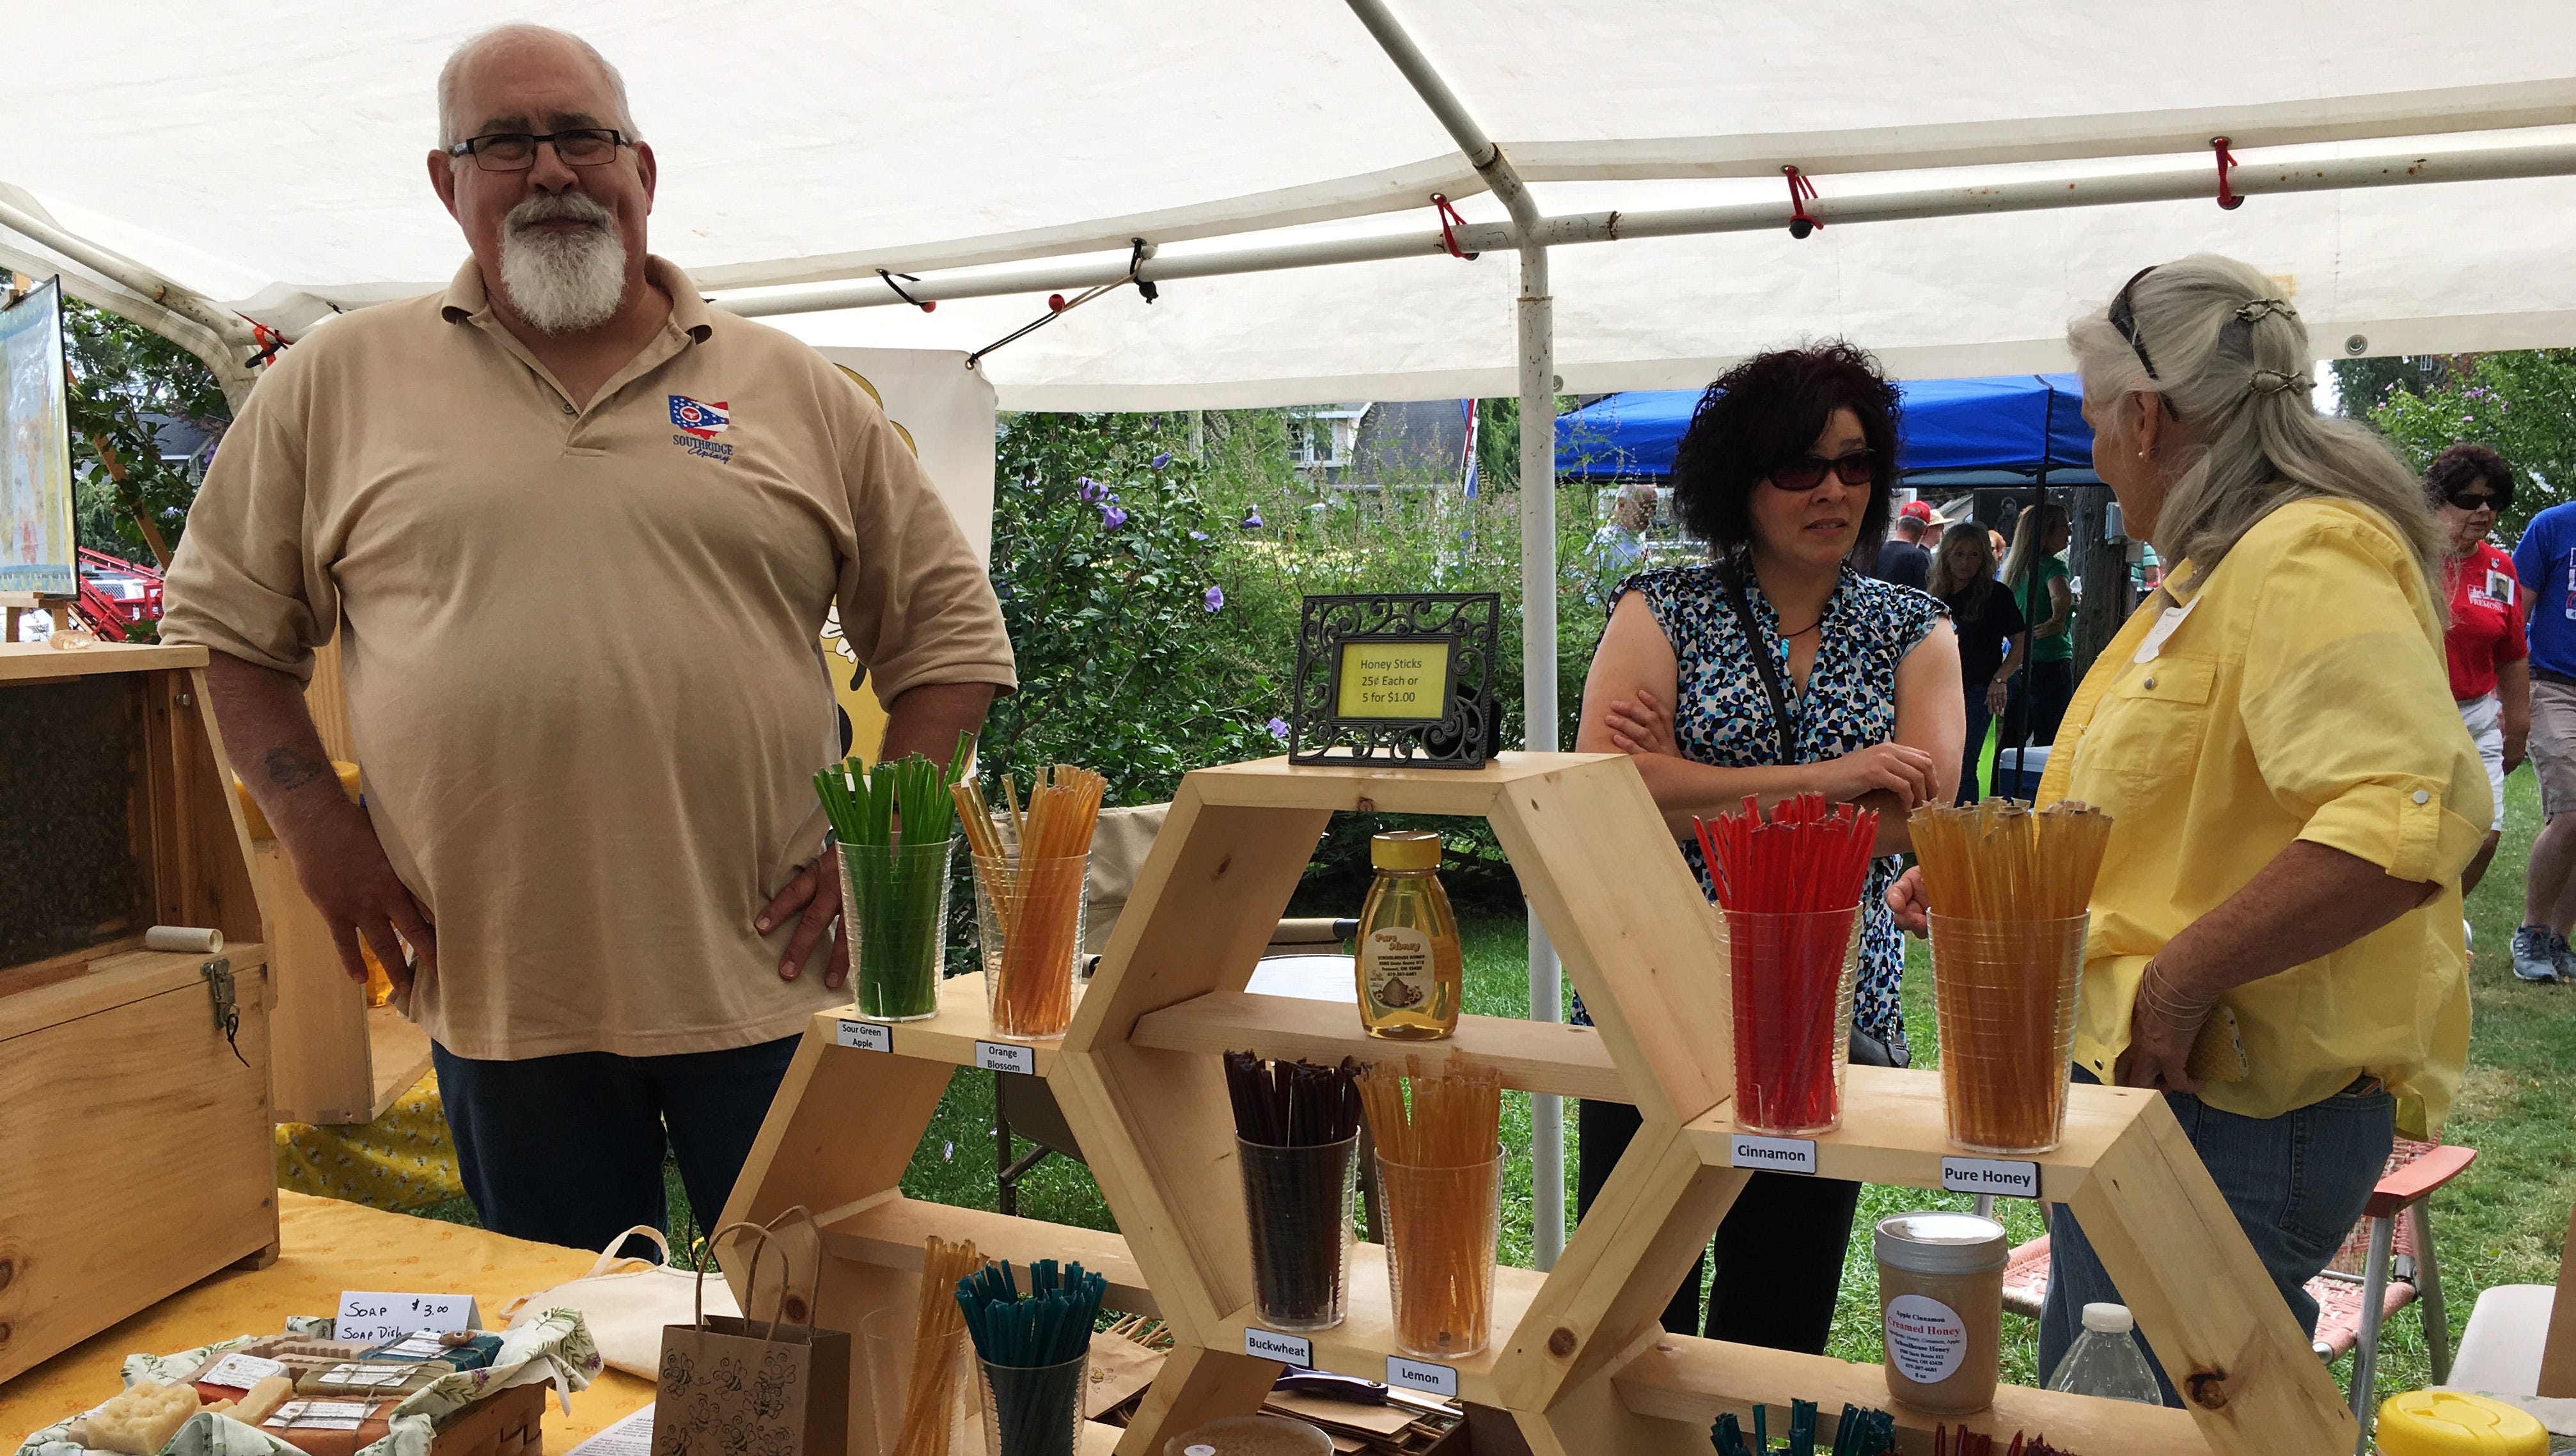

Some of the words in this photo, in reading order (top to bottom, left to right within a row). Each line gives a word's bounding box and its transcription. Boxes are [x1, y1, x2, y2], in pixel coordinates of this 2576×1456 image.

[673, 435, 734, 455] SOUTHRIDGE
[688, 448, 731, 464] Apiary
[1361, 660, 1392, 670] Honey
[1394, 658, 1422, 669] Sticks
[1382, 676, 1404, 686] Each
[1408, 677, 1418, 686] or
[1362, 693, 1368, 702] 5
[1371, 692, 1385, 702] for
[1388, 692, 1415, 703] $1.00
[1375, 933, 1397, 942] Pure
[1389, 941, 1420, 952] Honey
[842, 1024, 858, 1034] Sour
[860, 1026, 881, 1036] Green
[852, 1038, 873, 1048] Apple
[989, 1046, 1017, 1059] Orange
[987, 1059, 1020, 1072] Blossom
[1738, 1144, 1806, 1162] Cinnamon
[1945, 1167, 1978, 1182] Pure
[1983, 1170, 2031, 1188] Honey
[344, 1302, 388, 1317] SOAP
[1896, 1310, 1911, 1319] Apple
[1912, 1313, 1945, 1323] Cinnamon
[342, 1326, 373, 1340] SOAP
[377, 1325, 402, 1338] Dish
[1887, 1316, 1924, 1334] Creamed
[1927, 1325, 1961, 1337] Honey
[1249, 1337, 1305, 1357] Buckwheat
[1929, 1346, 1951, 1354] Honey
[1402, 1367, 1440, 1384] Lemon
